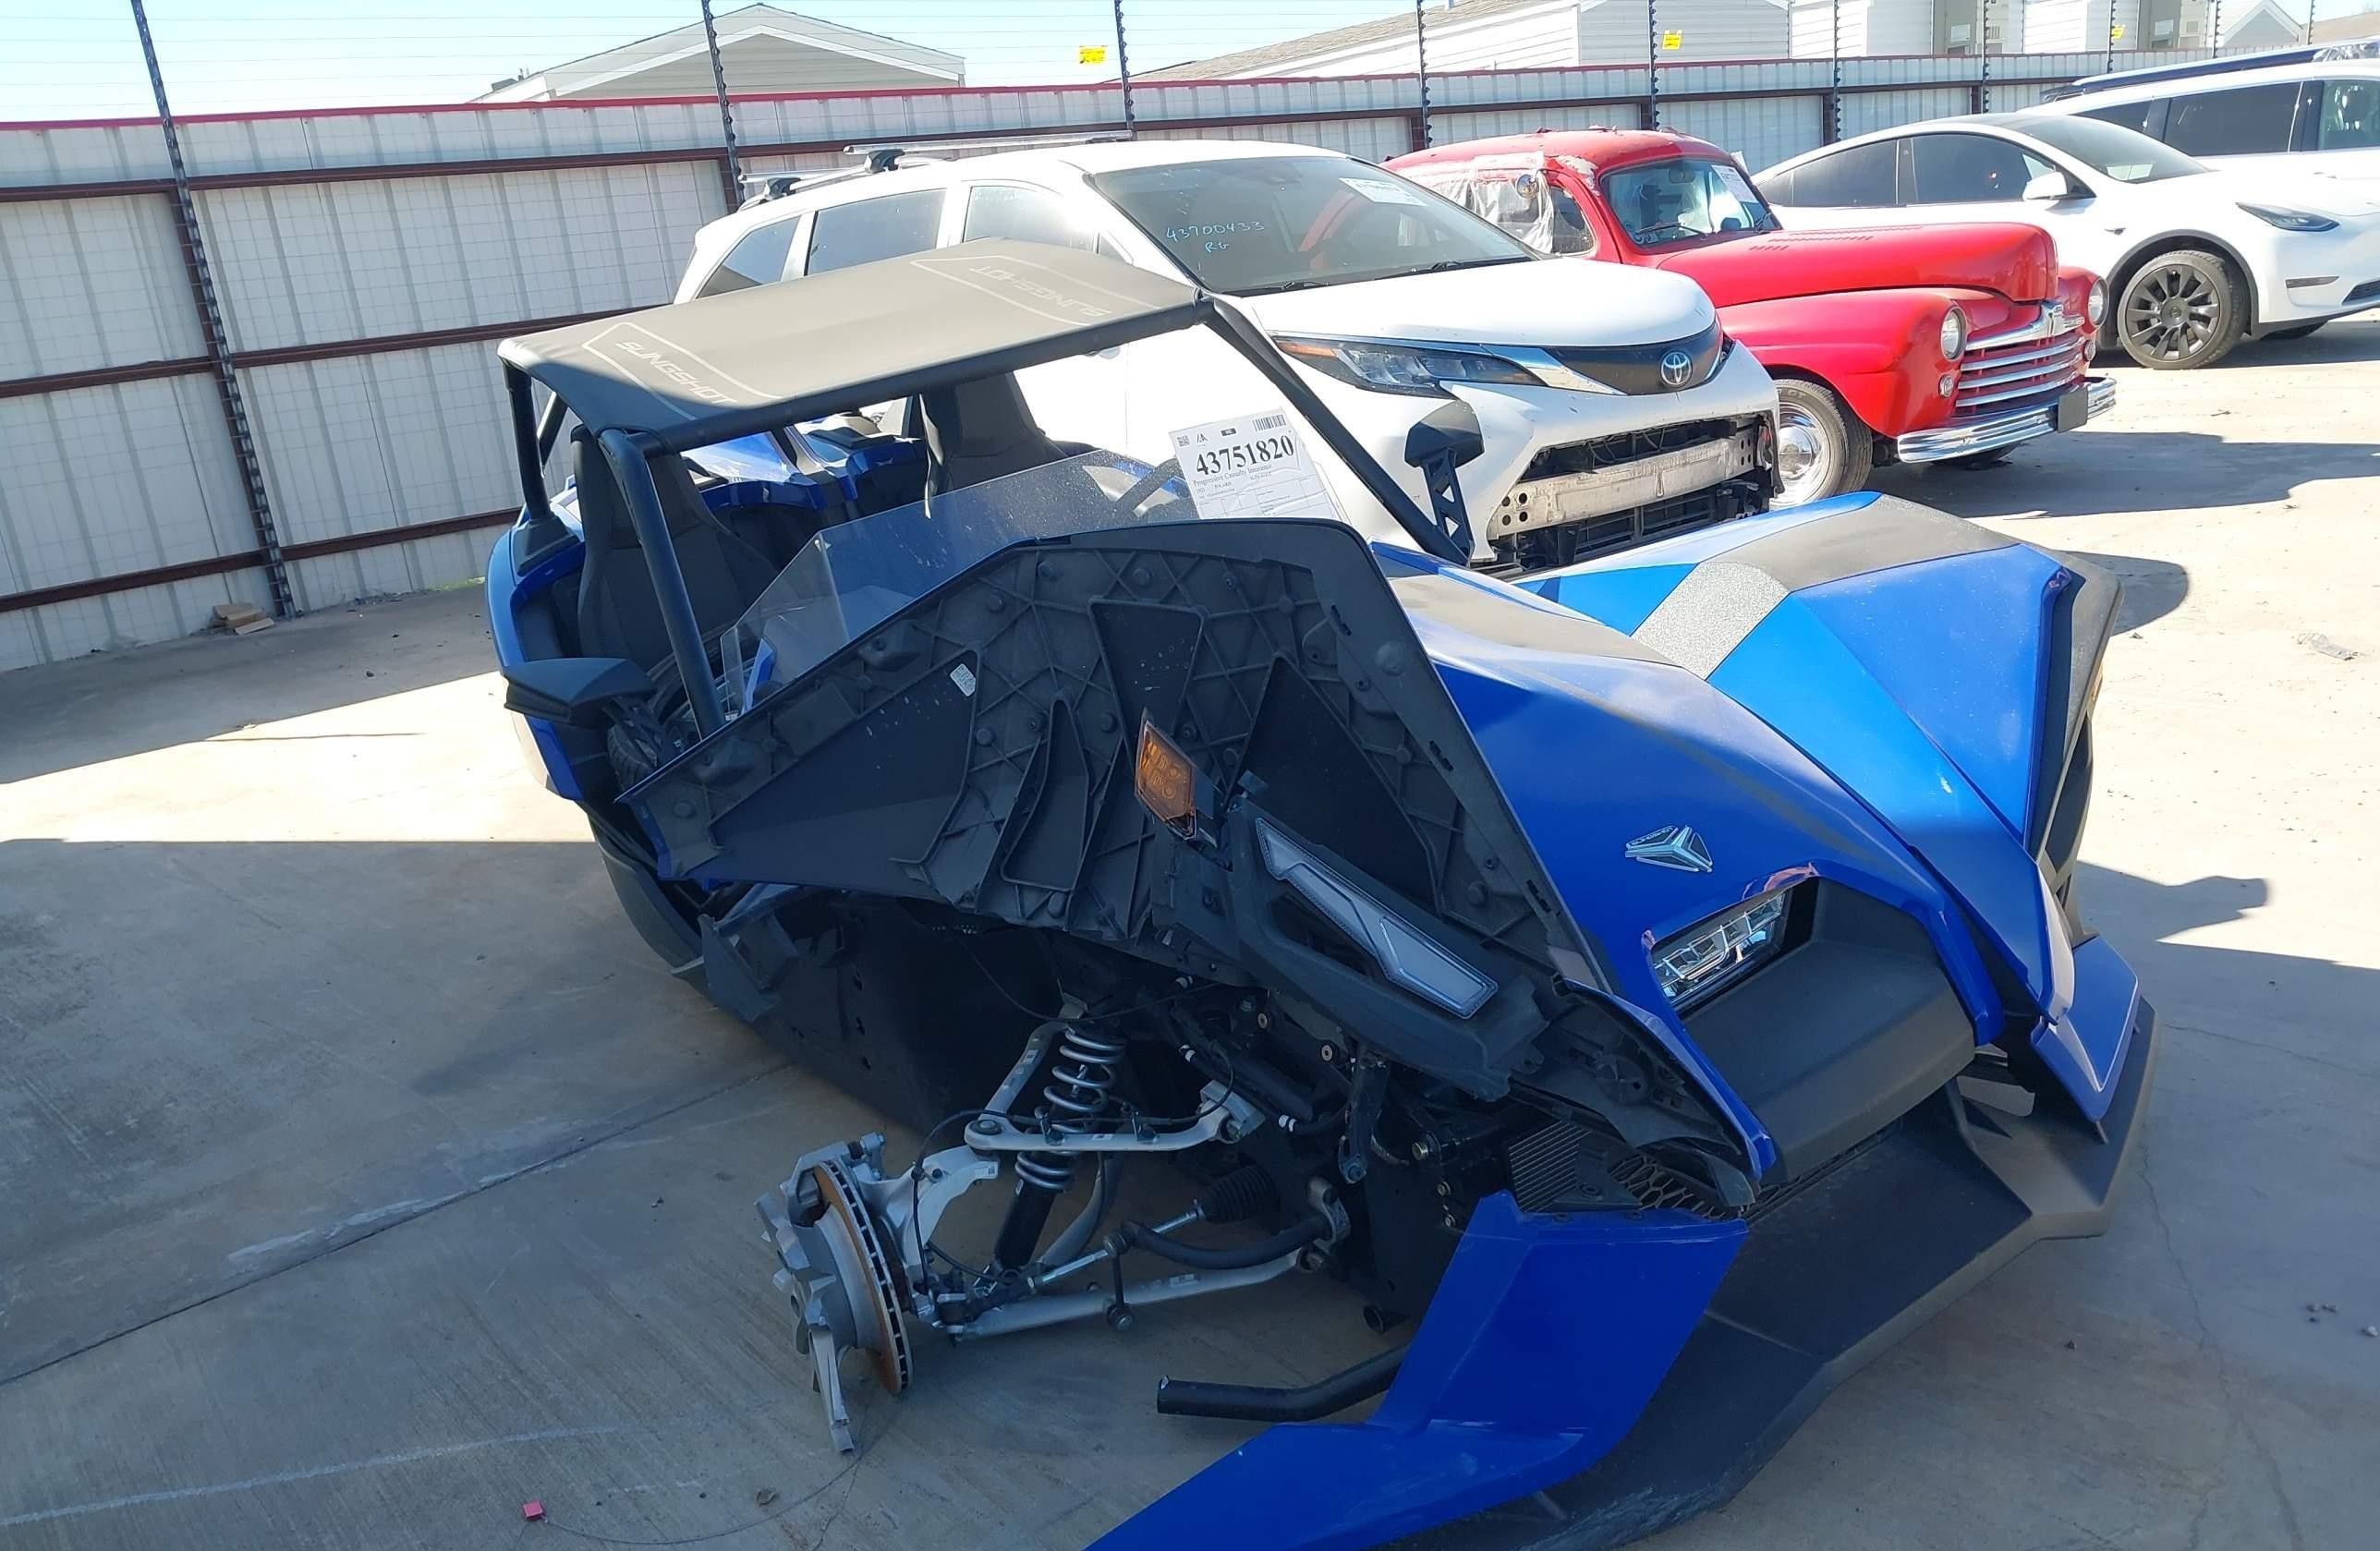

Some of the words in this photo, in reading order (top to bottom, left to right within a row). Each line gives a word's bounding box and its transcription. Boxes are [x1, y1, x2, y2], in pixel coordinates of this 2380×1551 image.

[1166, 221, 1265, 242] 43700433
[969, 265, 1112, 317] SLINGSHOT
[615, 340, 737, 405] SLINGSHOT
[1196, 435, 1293, 475] 43751820
